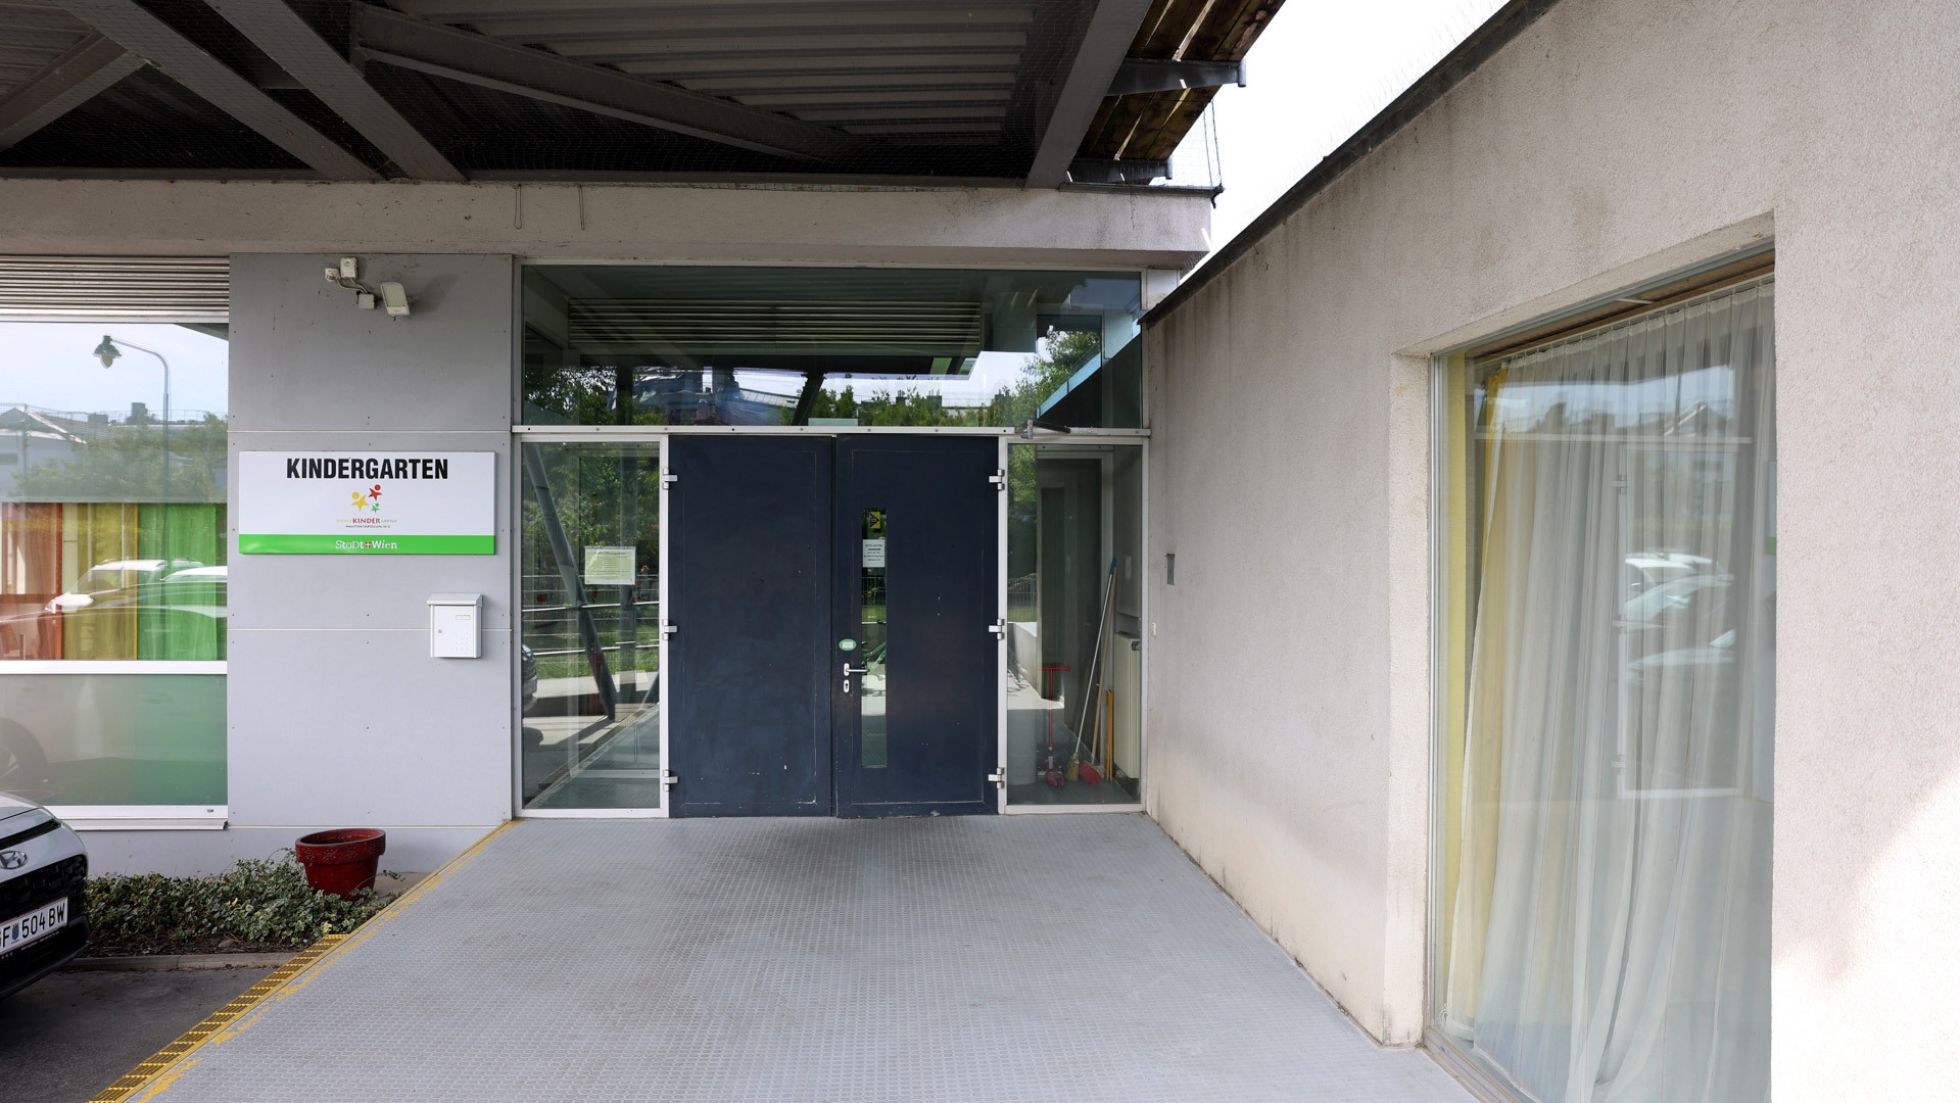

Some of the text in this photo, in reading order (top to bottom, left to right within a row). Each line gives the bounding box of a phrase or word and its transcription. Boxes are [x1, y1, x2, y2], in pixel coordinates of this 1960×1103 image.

[286, 458, 449, 480] KINDERGARTEN
[0, 926, 11, 948] F
[21, 912, 46, 939] 504
[48, 902, 65, 928] BW
